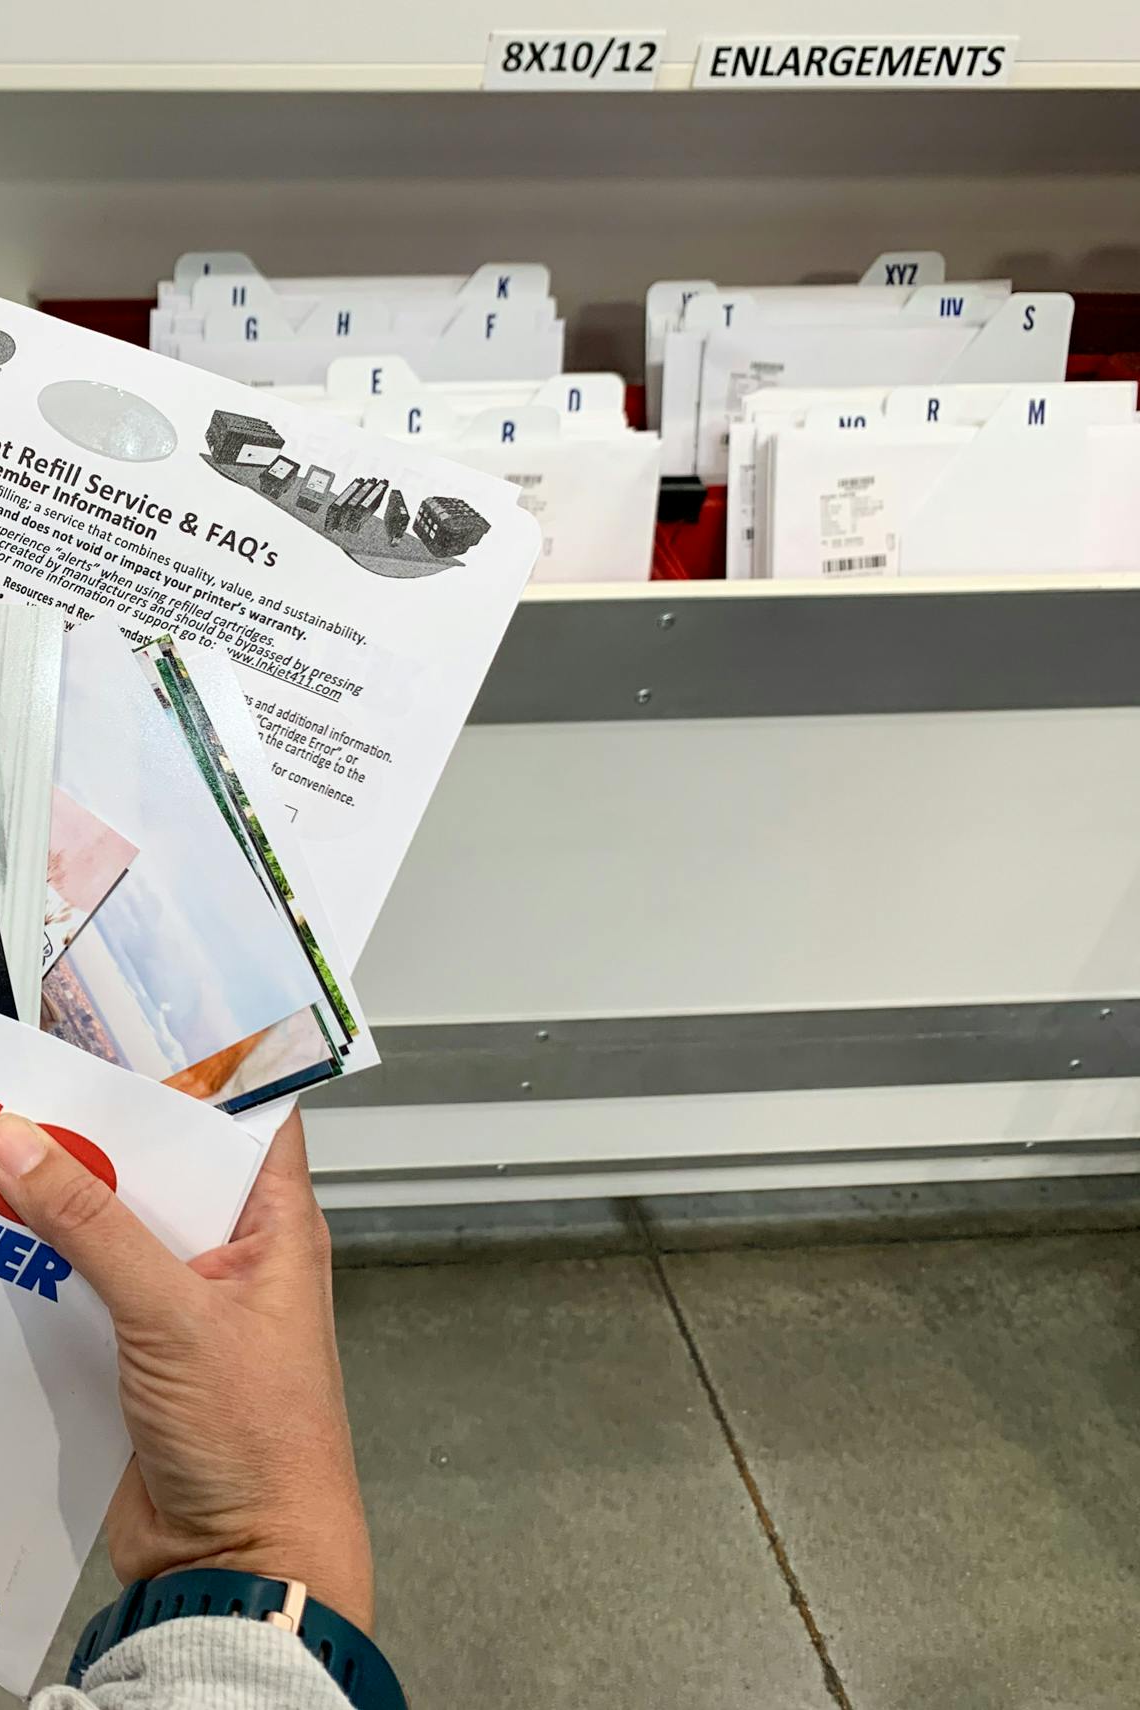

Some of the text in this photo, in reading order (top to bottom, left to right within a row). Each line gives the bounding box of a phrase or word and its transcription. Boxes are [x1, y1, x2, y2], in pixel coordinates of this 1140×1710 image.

[501, 38, 656, 79] 8X10/12
[709, 44, 1006, 78] ENLARGEMENTS
[497, 276, 509, 299] K
[884, 262, 918, 287] XYZ
[245, 316, 258, 341] G
[336, 311, 351, 336] H
[485, 313, 497, 339] F
[722, 304, 735, 328] T
[1022, 305, 1036, 332] S
[371, 367, 383, 395] E
[408, 408, 422, 434] C
[926, 398, 940, 423] R
[1027, 399, 1046, 425] M
[18, 446, 82, 487] Refill
[85, 474, 172, 525] Service
[179, 512, 198, 536] &
[52, 486, 157, 541] Information
[21, 515, 50, 534] does
[52, 529, 74, 544] not
[76, 539, 103, 556] void
[104, 552, 119, 563] or
[119, 555, 162, 581] impact
[163, 575, 193, 593] your
[249, 610, 306, 640] warranty.
[34, 504, 41, 513] a
[43, 508, 85, 530] service
[88, 524, 113, 542] that
[114, 537, 171, 566] combines
[173, 561, 215, 587] quality,
[221, 580, 254, 602] value,
[258, 596, 283, 611] and
[283, 606, 366, 645] sustainability.
[3, 576, 54, 606] Resources
[12, 559, 44, 577] more
[45, 571, 115, 608] information
[117, 603, 132, 613] or
[132, 610, 180, 635] support
[179, 630, 196, 641] go
[198, 635, 217, 649] to:
[0, 540, 45, 564] created
[45, 557, 62, 573] by
[62, 567, 149, 608] manufacturers
[150, 601, 175, 618] and
[174, 613, 217, 635] should
[216, 628, 233, 642] be
[234, 635, 293, 666] bypassed
[292, 659, 310, 676] by
[308, 669, 364, 696] pressing
[101, 569, 133, 589] when
[135, 584, 168, 605] using
[168, 598, 213, 623] refilled
[213, 617, 274, 647] cartridges.
[255, 700, 276, 714] and
[276, 709, 329, 736] additional
[329, 728, 392, 763] information.
[266, 734, 283, 749] the
[285, 744, 331, 769] cartridge
[333, 762, 345, 774] to
[347, 768, 365, 783] the
[345, 755, 359, 765] or
[271, 762, 354, 806] for convenience.
